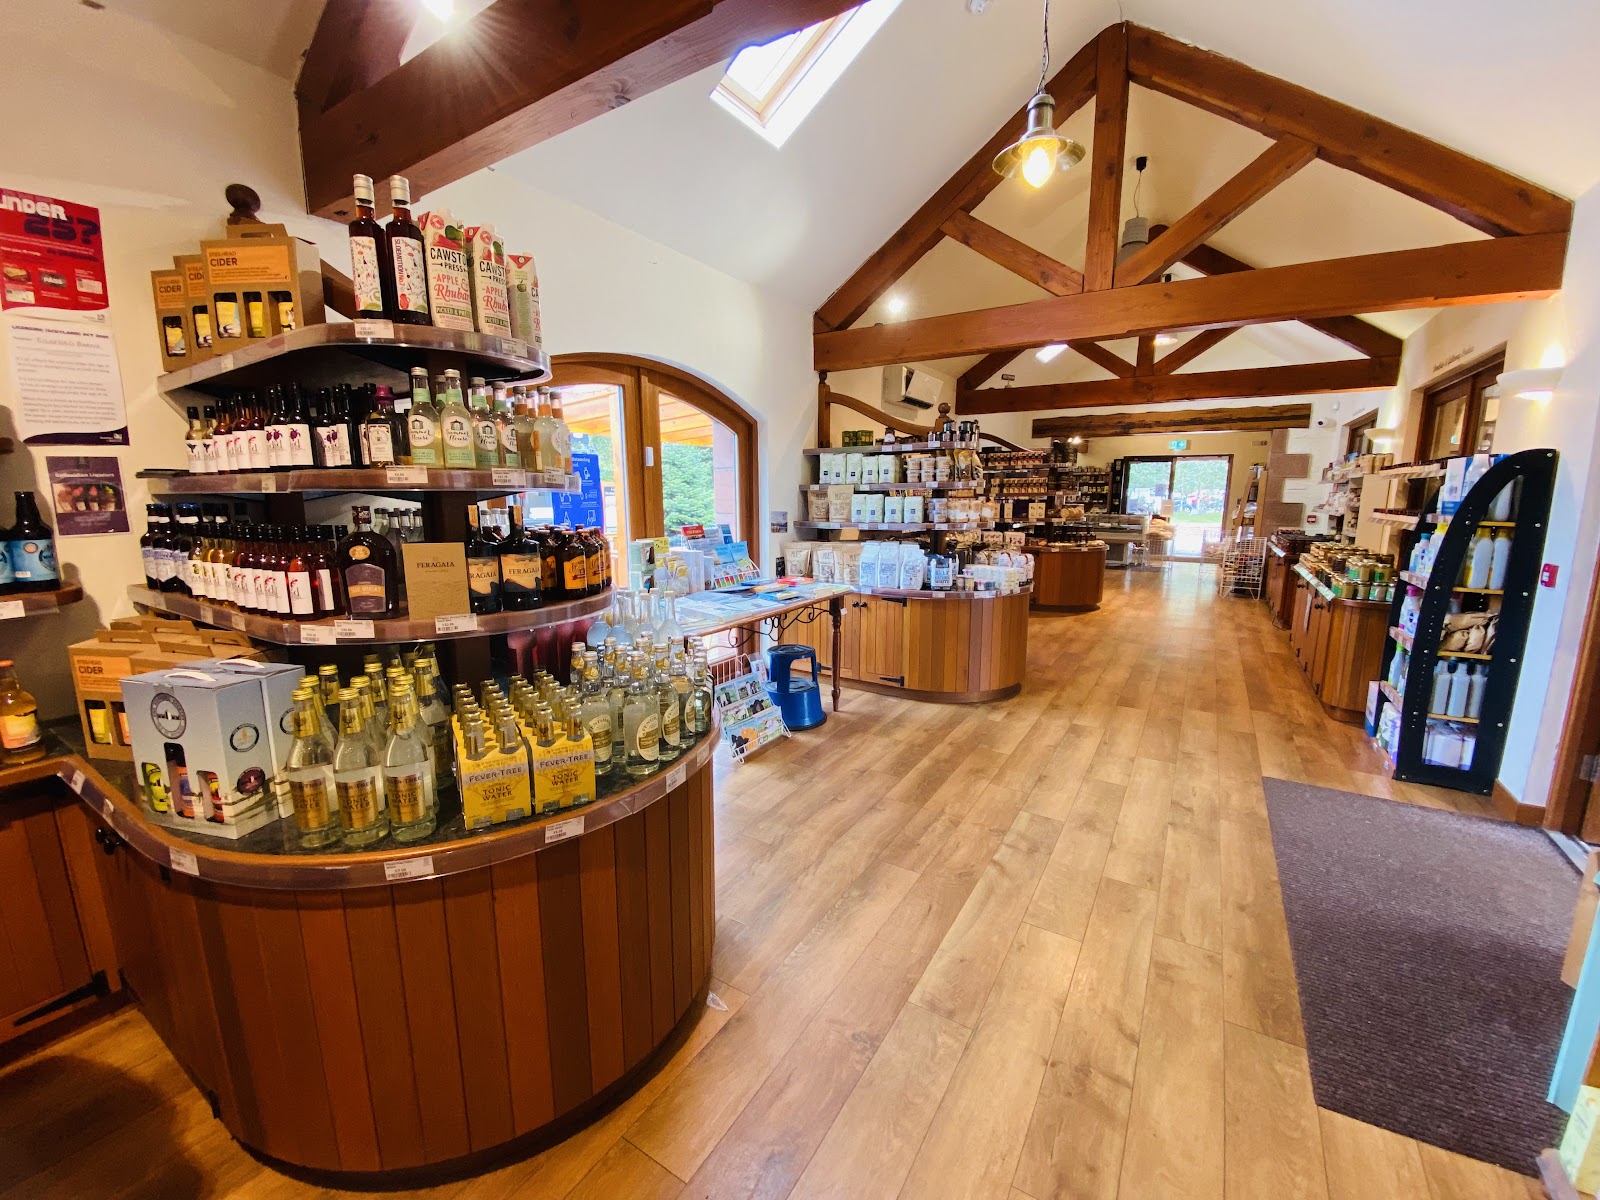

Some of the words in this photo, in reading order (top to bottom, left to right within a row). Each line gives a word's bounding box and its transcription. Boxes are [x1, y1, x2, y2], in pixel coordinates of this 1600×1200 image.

[209, 257, 238, 267] CIDER
[430, 247, 467, 266] CAWSTO
[479, 260, 505, 277] CAWST
[188, 272, 204, 281] CID
[436, 273, 459, 286] APPLE
[158, 284, 182, 293] CIDER
[485, 285, 504, 298] APPLE
[416, 561, 455, 569] FERAGAIA
[468, 571, 497, 579] RAGAIA
[78, 665, 104, 675] CIDER
[540, 753, 588, 768] FEVER-TREE
[469, 766, 522, 783] FEVER-TREE
[552, 770, 579, 781] TONIC
[551, 776, 579, 787] WATER
[483, 784, 511, 796] TONIC
[482, 790, 512, 802] WATER
